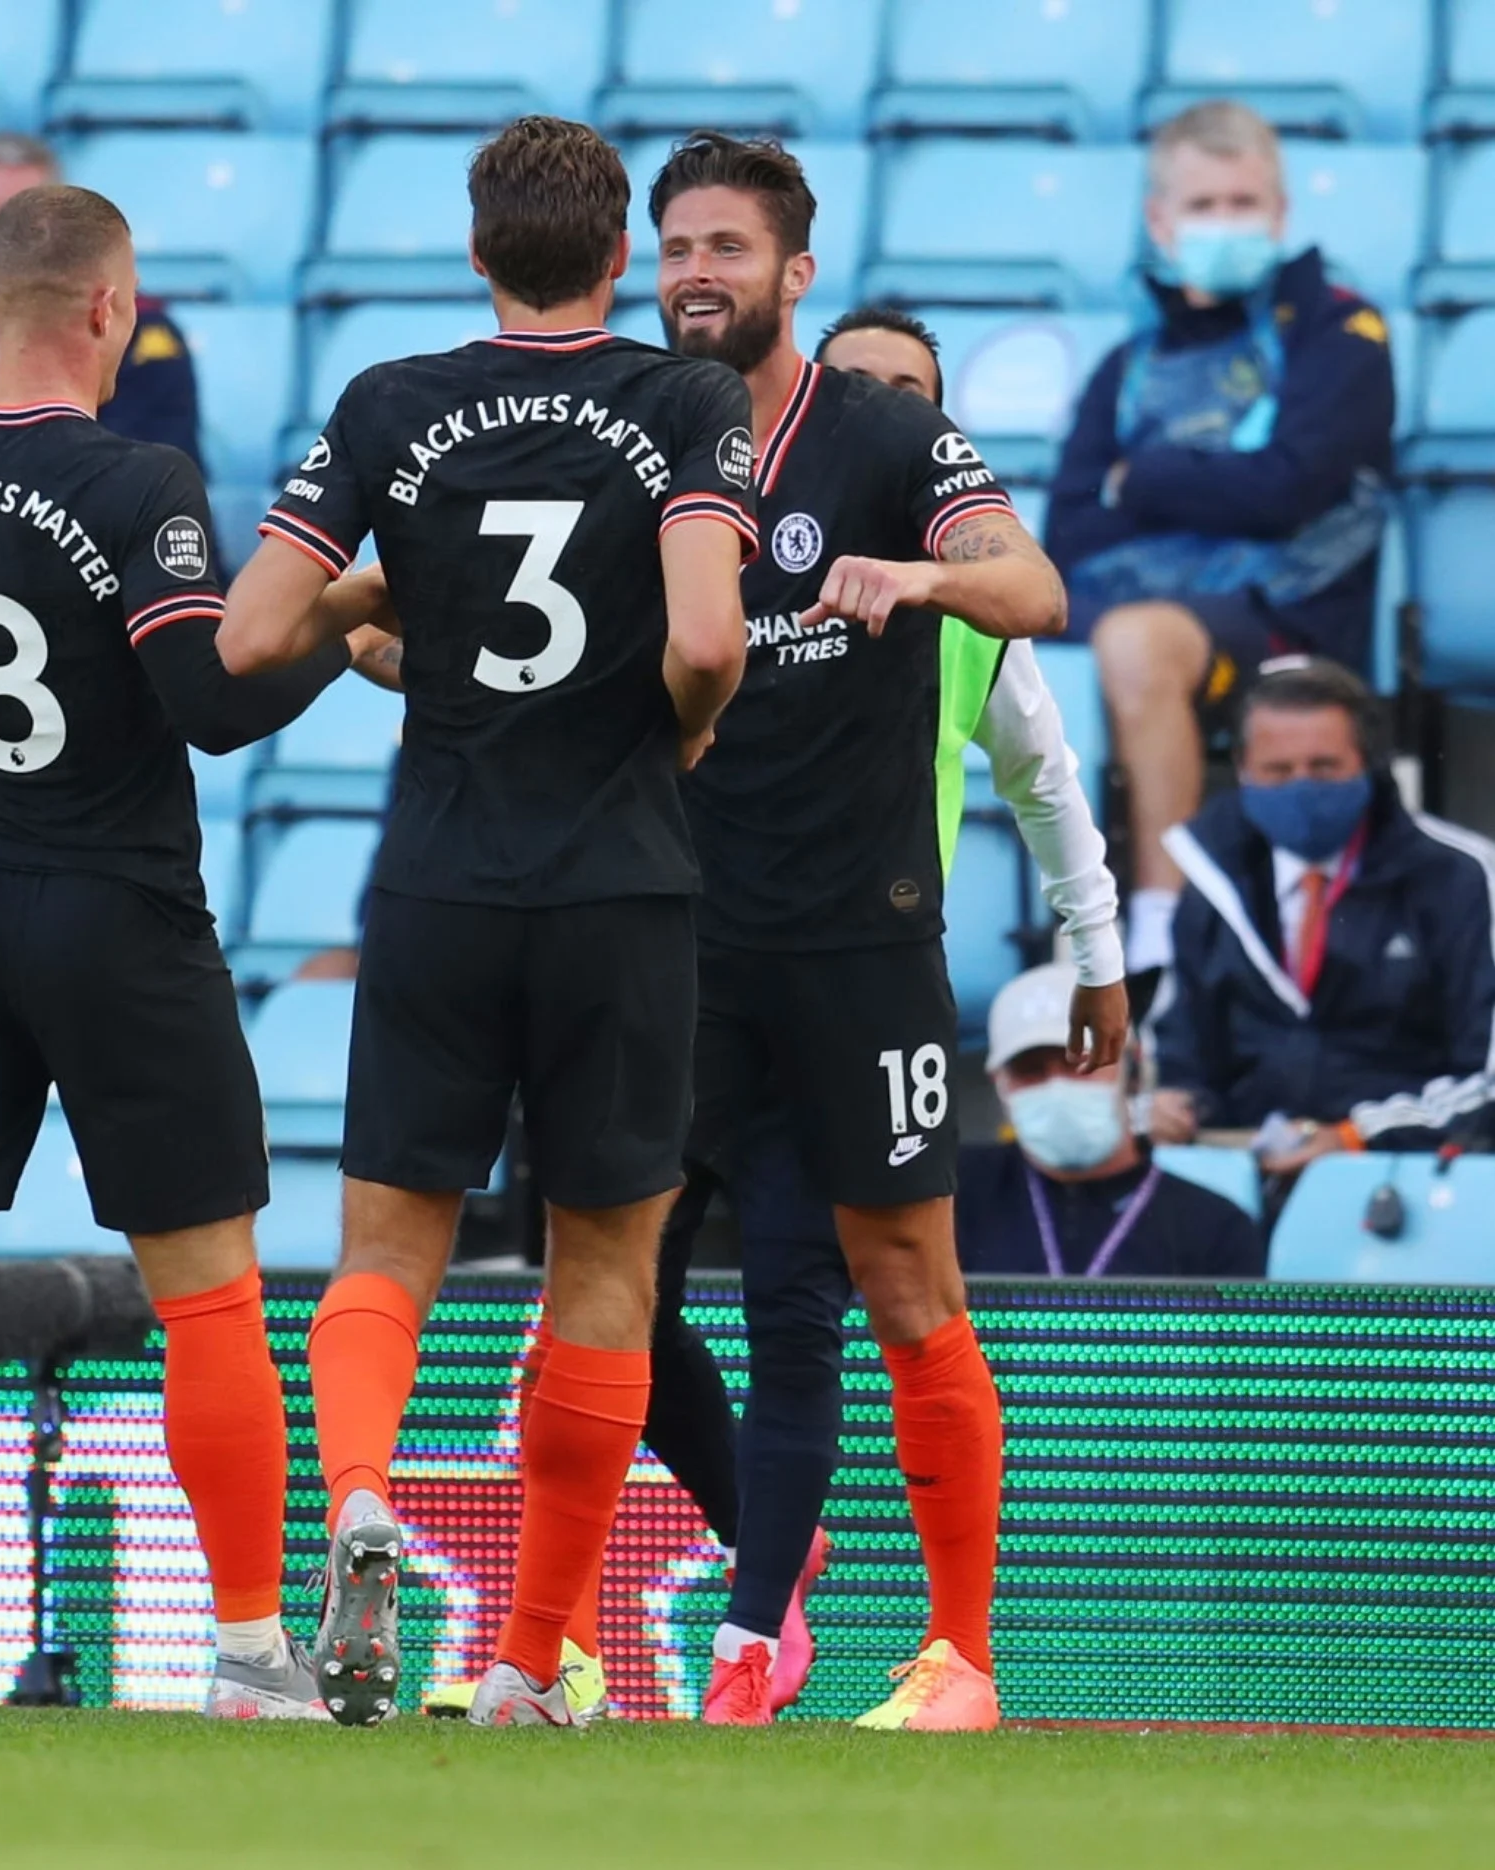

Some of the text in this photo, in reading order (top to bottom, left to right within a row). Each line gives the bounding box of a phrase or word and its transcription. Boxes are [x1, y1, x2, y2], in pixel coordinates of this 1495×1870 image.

[387, 394, 672, 506] BLACK LIVES MATTER
[19, 490, 121, 602] MATTER
[473, 501, 587, 693] 3
[776, 635, 849, 667] TYRES
[878, 1042, 948, 1134] 18
